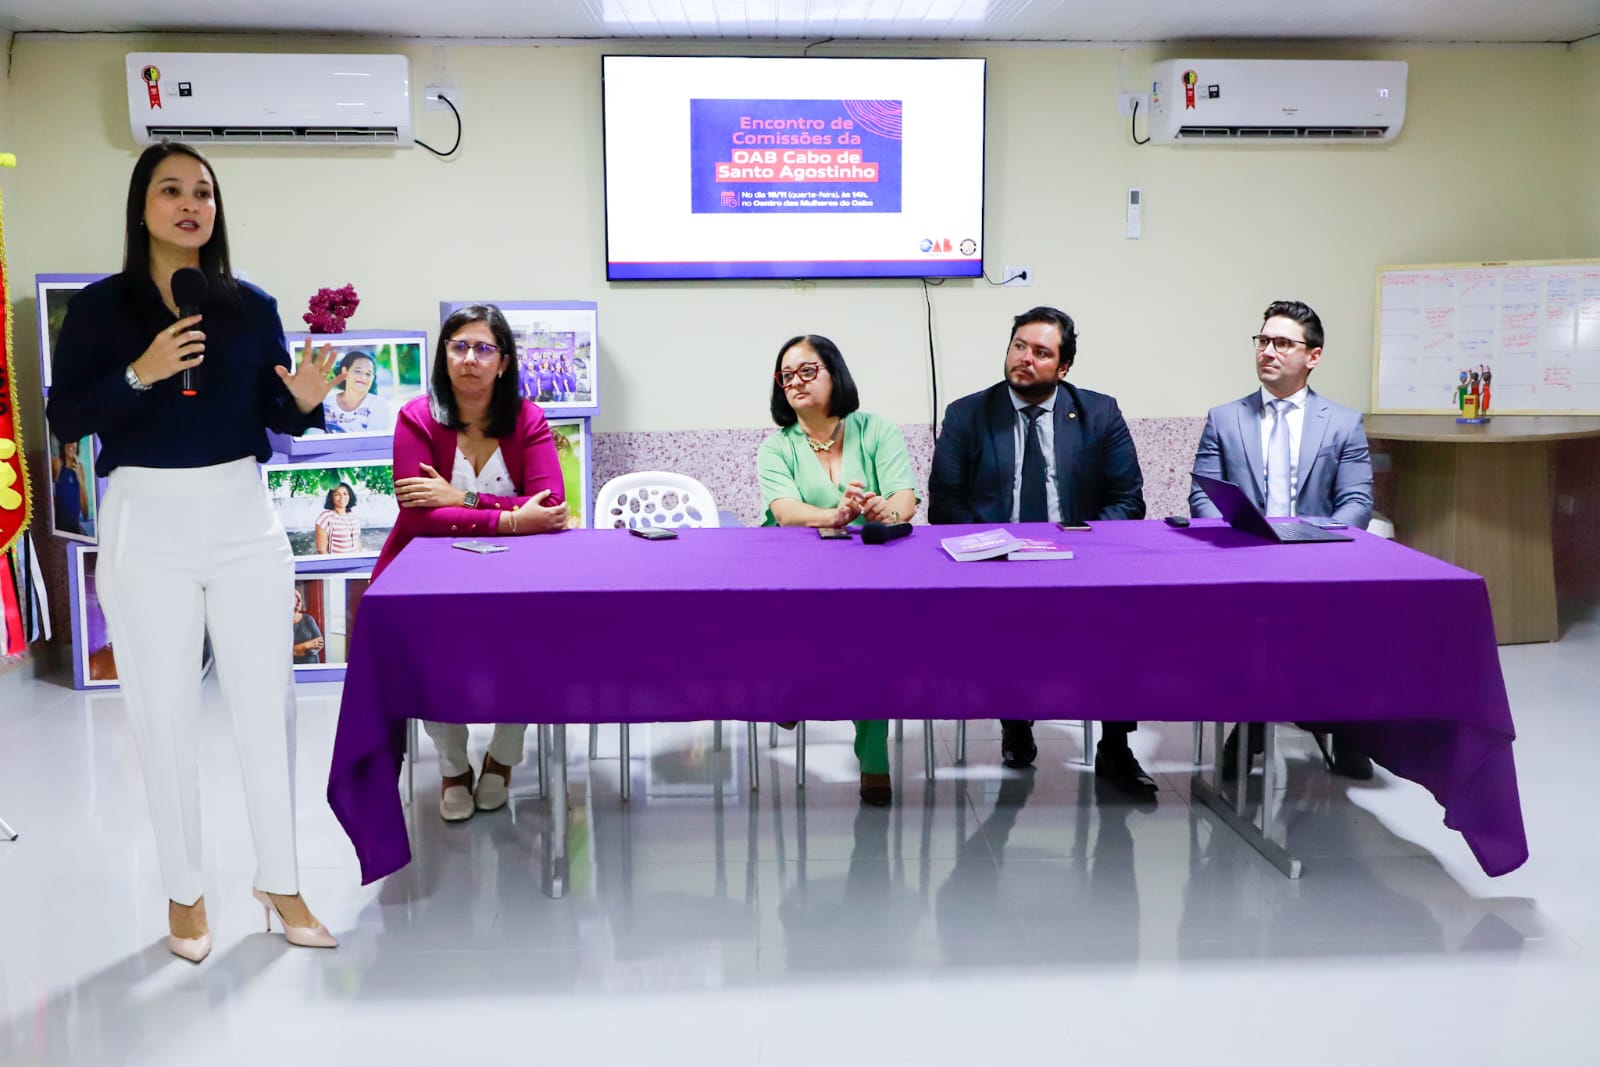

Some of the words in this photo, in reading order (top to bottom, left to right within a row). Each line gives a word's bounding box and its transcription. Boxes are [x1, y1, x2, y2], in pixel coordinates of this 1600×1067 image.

[740, 116, 825, 130] Encontro
[830, 116, 854, 130] de
[732, 131, 832, 145] Comissões
[837, 132, 861, 145] da
[733, 151, 777, 164] OAB
[783, 151, 832, 164] Cabo
[836, 151, 861, 164] de
[718, 165, 774, 179] Santo
[779, 165, 876, 181] Agostinho
[741, 191, 753, 199] No
[754, 191, 766, 199] dia
[919, 238, 953, 253] OAB
